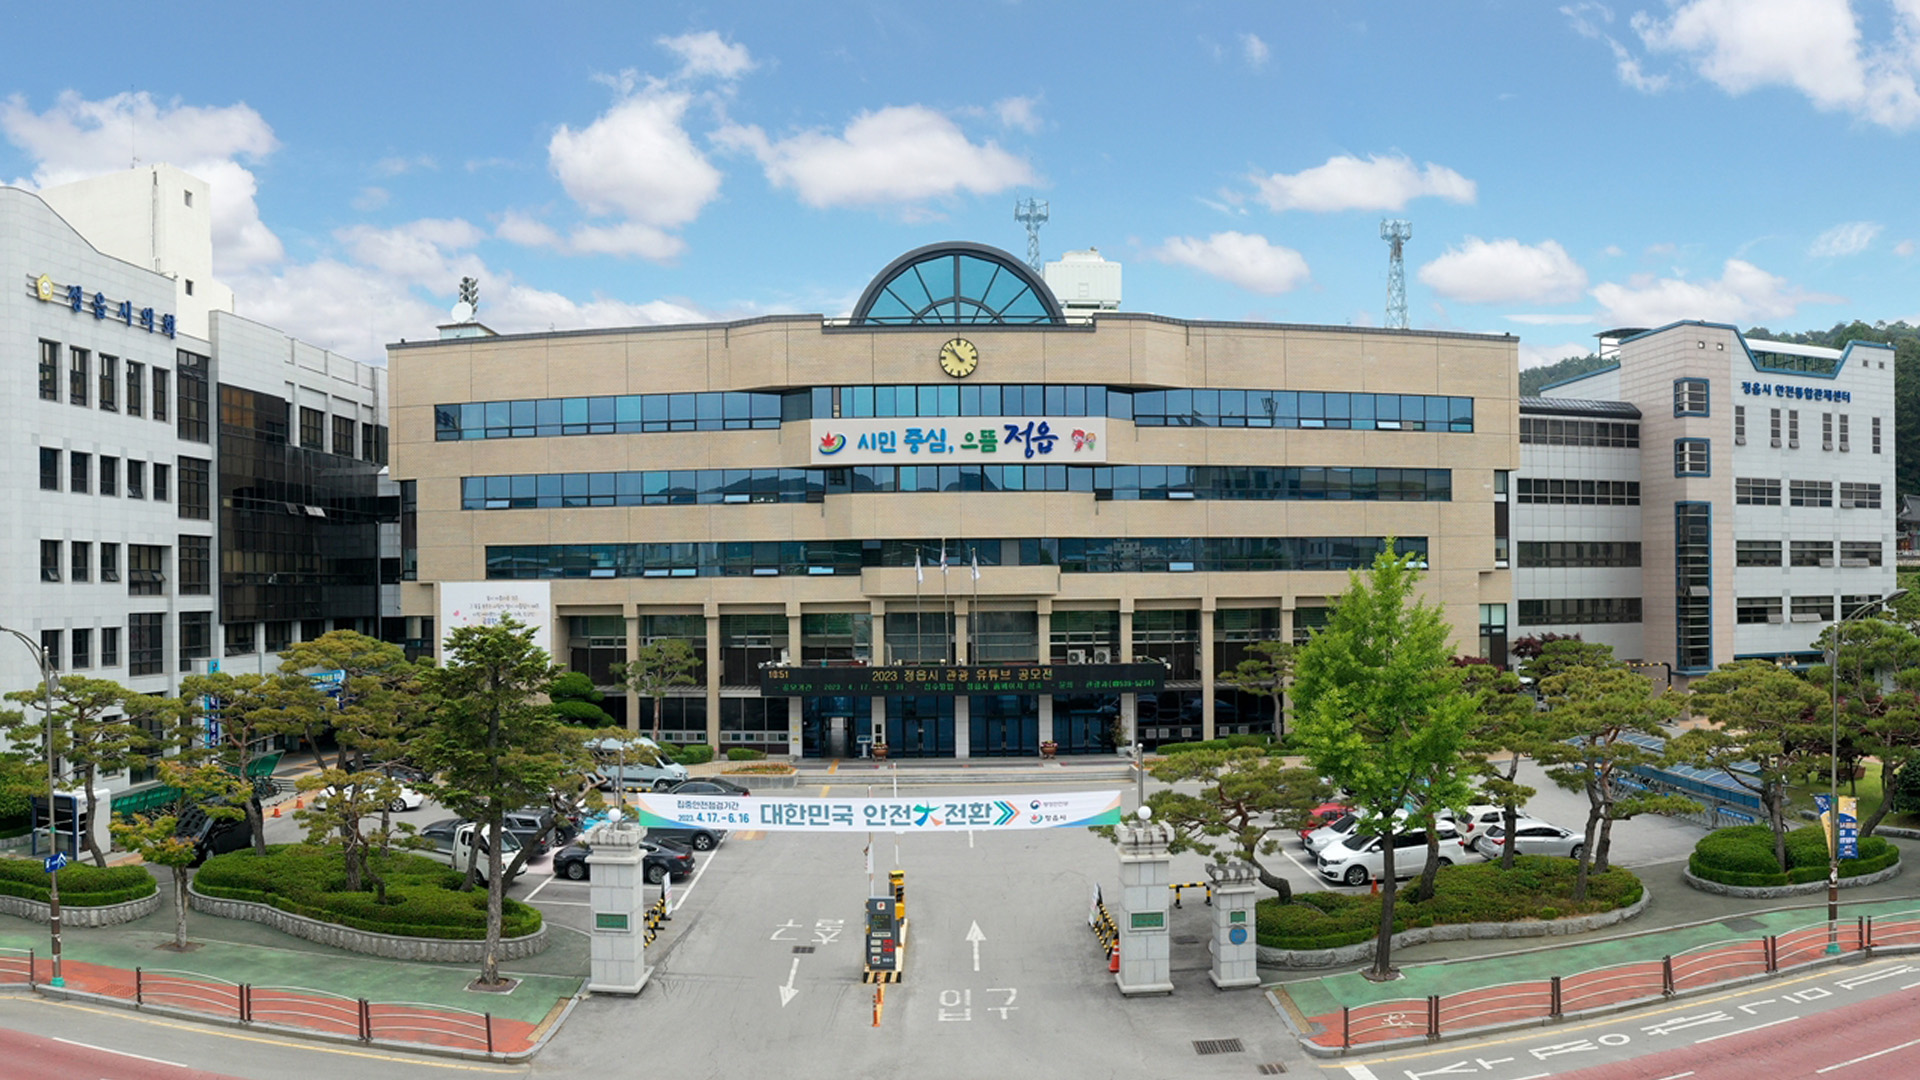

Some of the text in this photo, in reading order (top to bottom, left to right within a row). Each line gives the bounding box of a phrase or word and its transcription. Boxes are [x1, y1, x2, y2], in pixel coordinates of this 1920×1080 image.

[66, 285, 176, 339] 정읍시의회
[1742, 381, 1851, 403] 정읍시 안전통합관제센터
[858, 421, 1058, 458] 시민 중심, 으뜸 정읍
[872, 668, 1053, 682] 2023 정읍시 관광 유튜브 공모전
[677, 800, 739, 811] 집중안전점검기간
[760, 803, 854, 826] 대한민국
[938, 988, 1019, 1021] 입구
